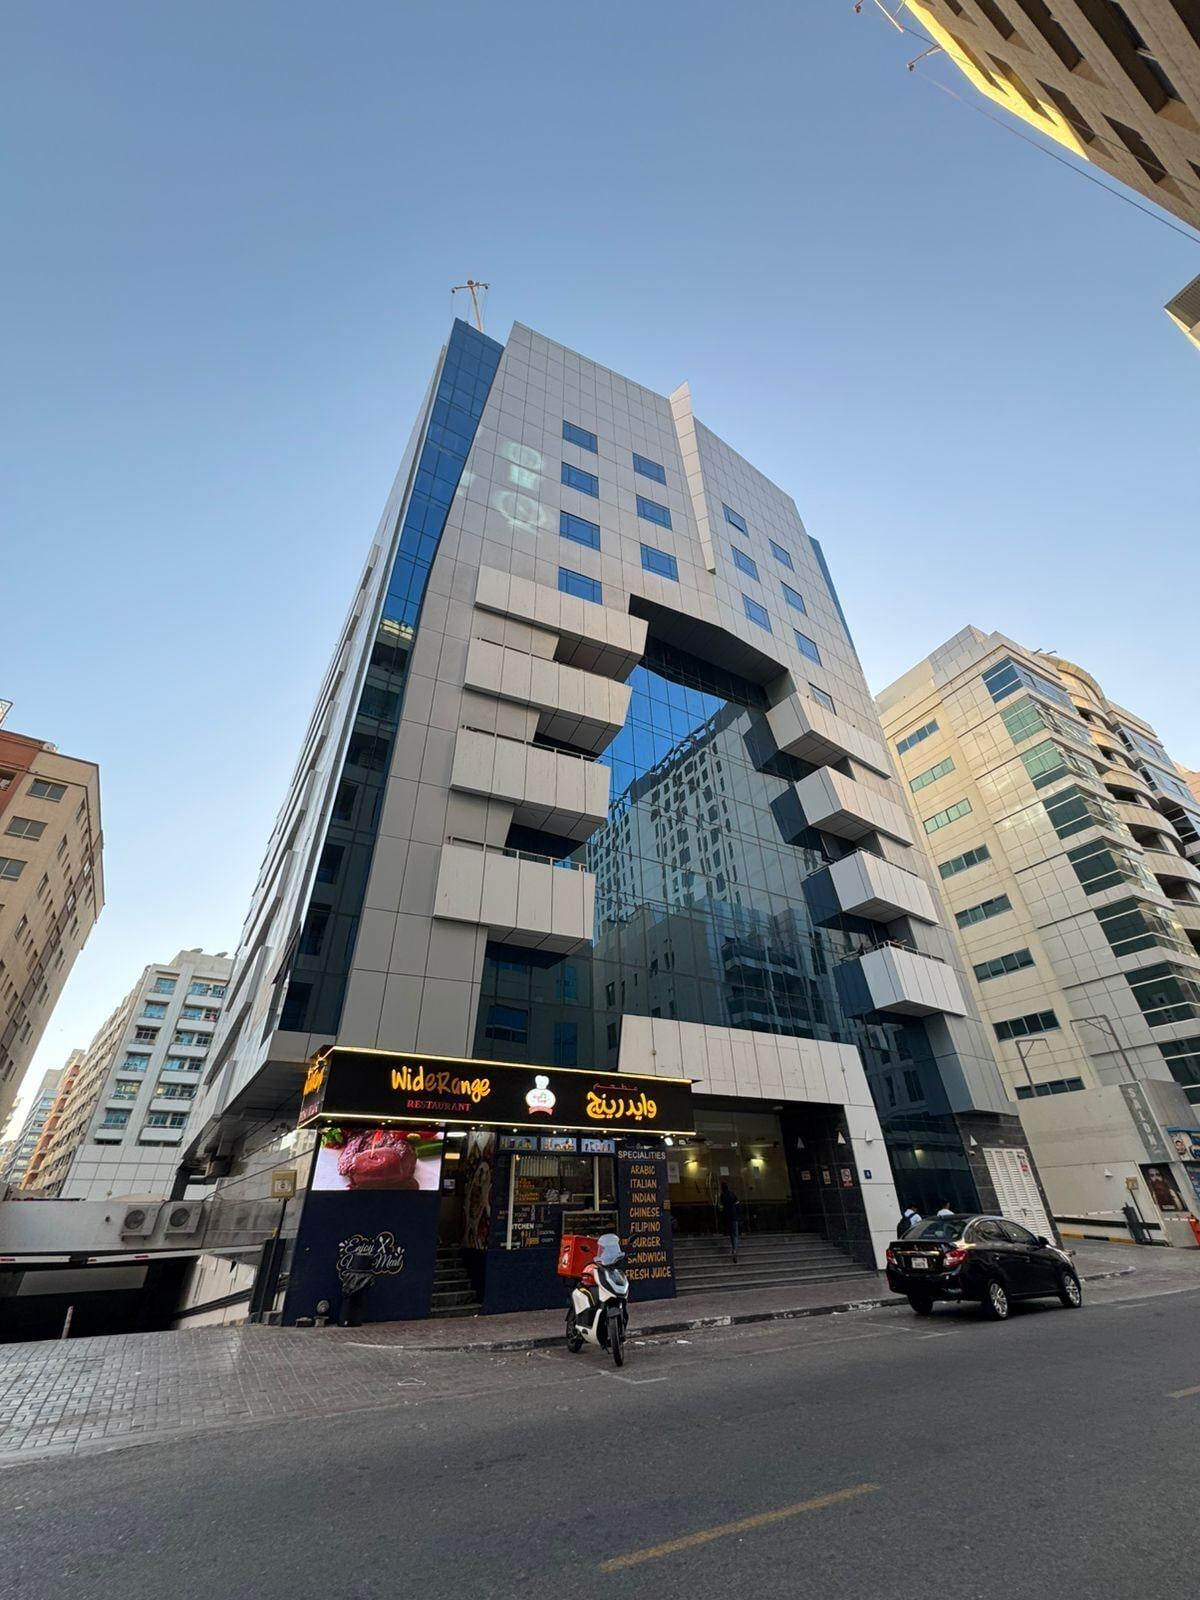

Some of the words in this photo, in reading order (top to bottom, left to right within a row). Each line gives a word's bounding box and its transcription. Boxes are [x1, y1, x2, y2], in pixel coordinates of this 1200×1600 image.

[406, 1100, 472, 1112] RESTAURANT
[617, 1150, 666, 1160] SPECIALITIES
[630, 1164, 656, 1175] ARABIC
[630, 1179, 657, 1189] ITALIAN
[632, 1193, 657, 1203] INDIAN
[629, 1207, 661, 1218] CHINESE
[630, 1221, 661, 1233] FILIPINO
[625, 1268, 650, 1280] FRESH
[650, 1265, 671, 1279] JUICE
